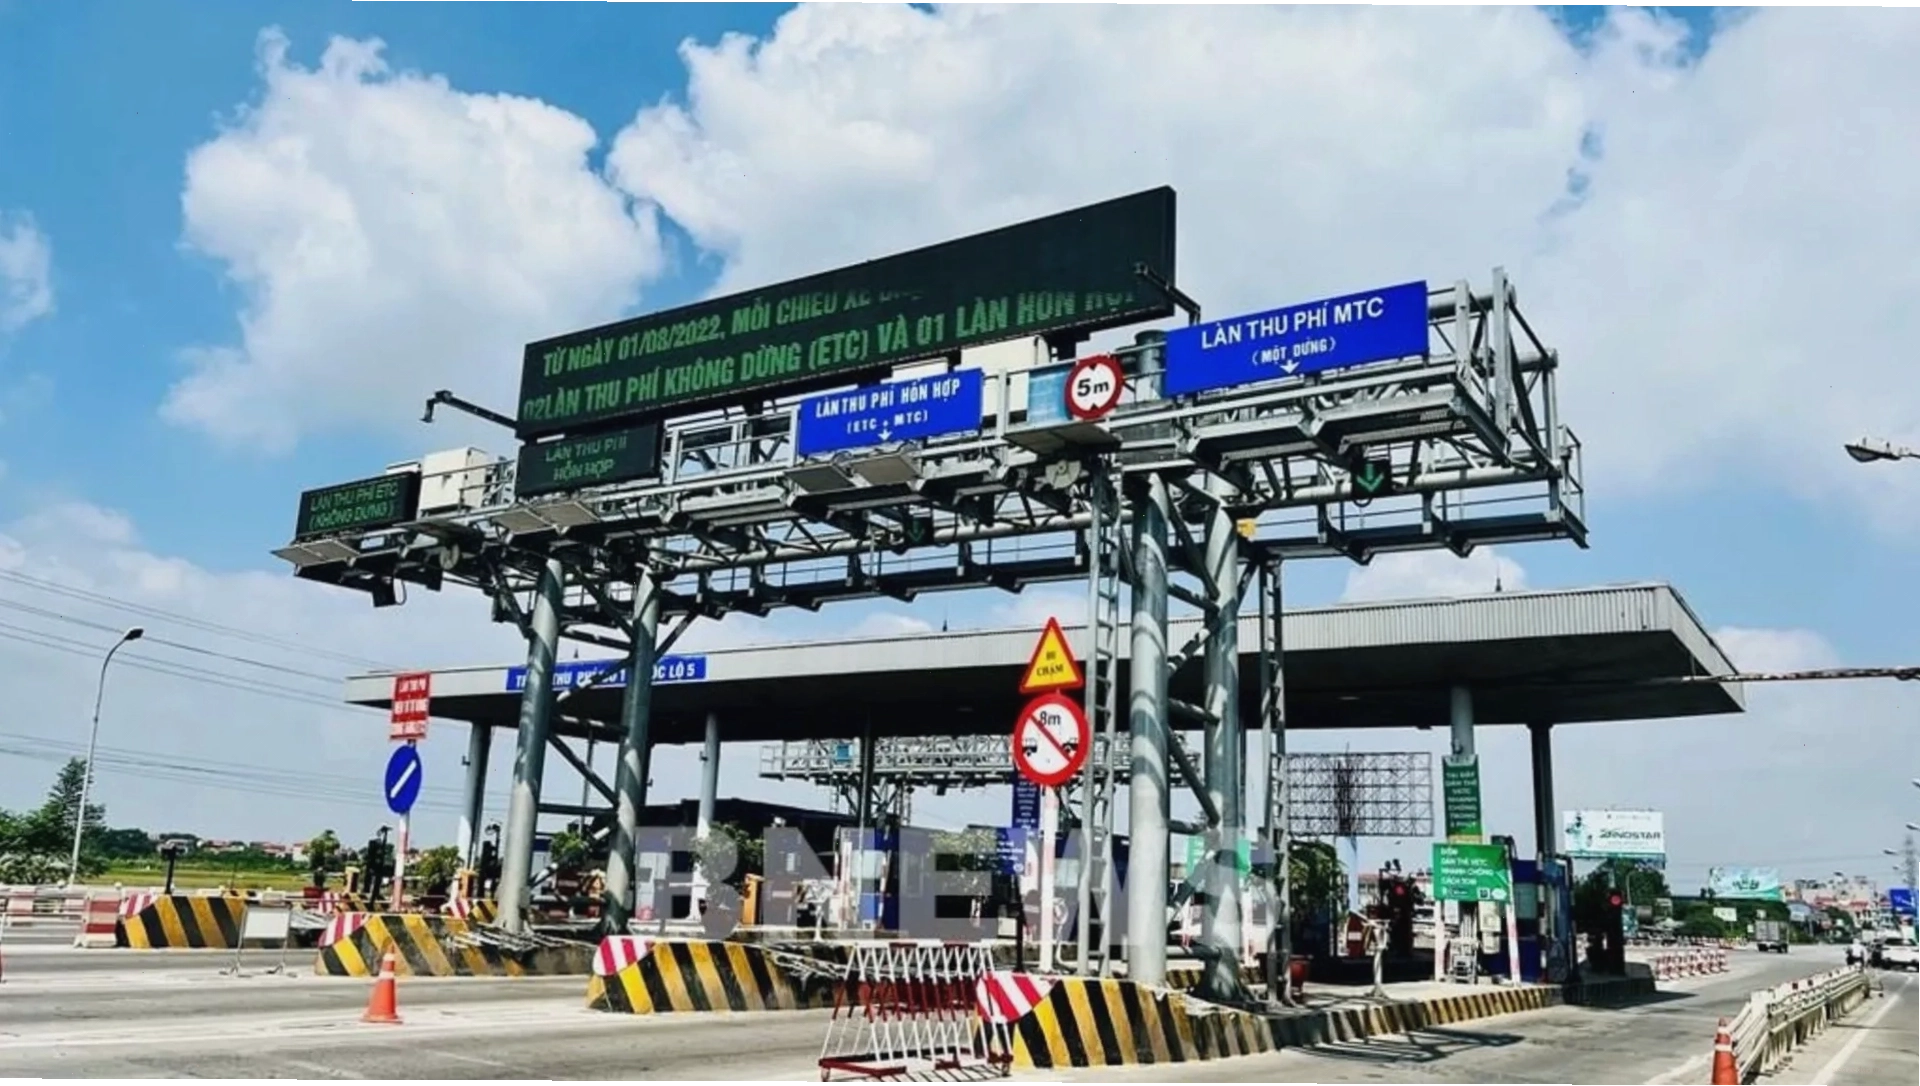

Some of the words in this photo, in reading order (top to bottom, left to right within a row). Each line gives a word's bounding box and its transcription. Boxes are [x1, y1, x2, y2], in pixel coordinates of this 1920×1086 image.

[1201, 322, 1242, 349] LÀN
[1246, 314, 1288, 340] THU
[1293, 302, 1328, 332] PHÍ
[1333, 297, 1384, 325] MTC
[567, 337, 616, 371] NGÀY
[584, 379, 622, 411] THU
[626, 366, 661, 405] PHÍ
[664, 356, 735, 396] KHÔNG
[740, 341, 802, 381] DỪNG
[808, 329, 869, 370] (ETC)
[877, 313, 910, 354] VÀ
[916, 313, 945, 346] 01
[956, 296, 1008, 338] LÀN
[815, 396, 839, 418] LÀN
[841, 394, 867, 414] THU
[870, 385, 895, 409] PHÍ
[932, 378, 961, 402] HỢP
[687, 662, 695, 677] 5
